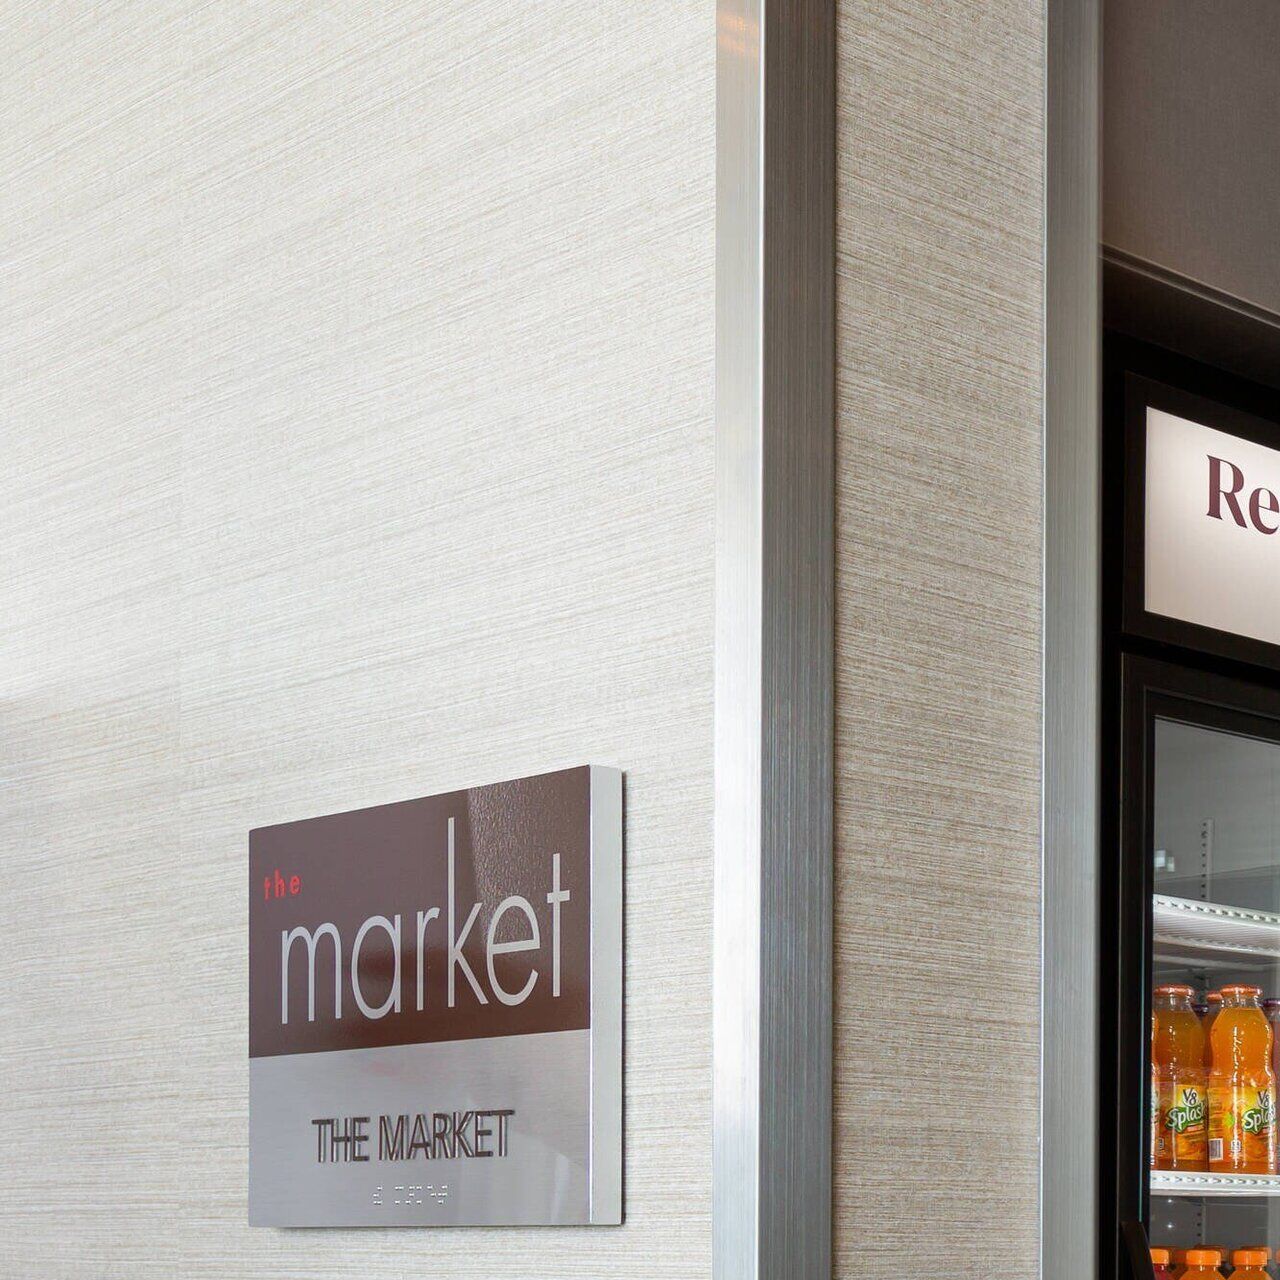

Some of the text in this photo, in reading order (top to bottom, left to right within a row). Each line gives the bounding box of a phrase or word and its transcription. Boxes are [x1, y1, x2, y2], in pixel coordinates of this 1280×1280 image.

[264, 869, 300, 899] the
[281, 817, 570, 1024] market
[312, 1109, 514, 1162] THE MARKET
